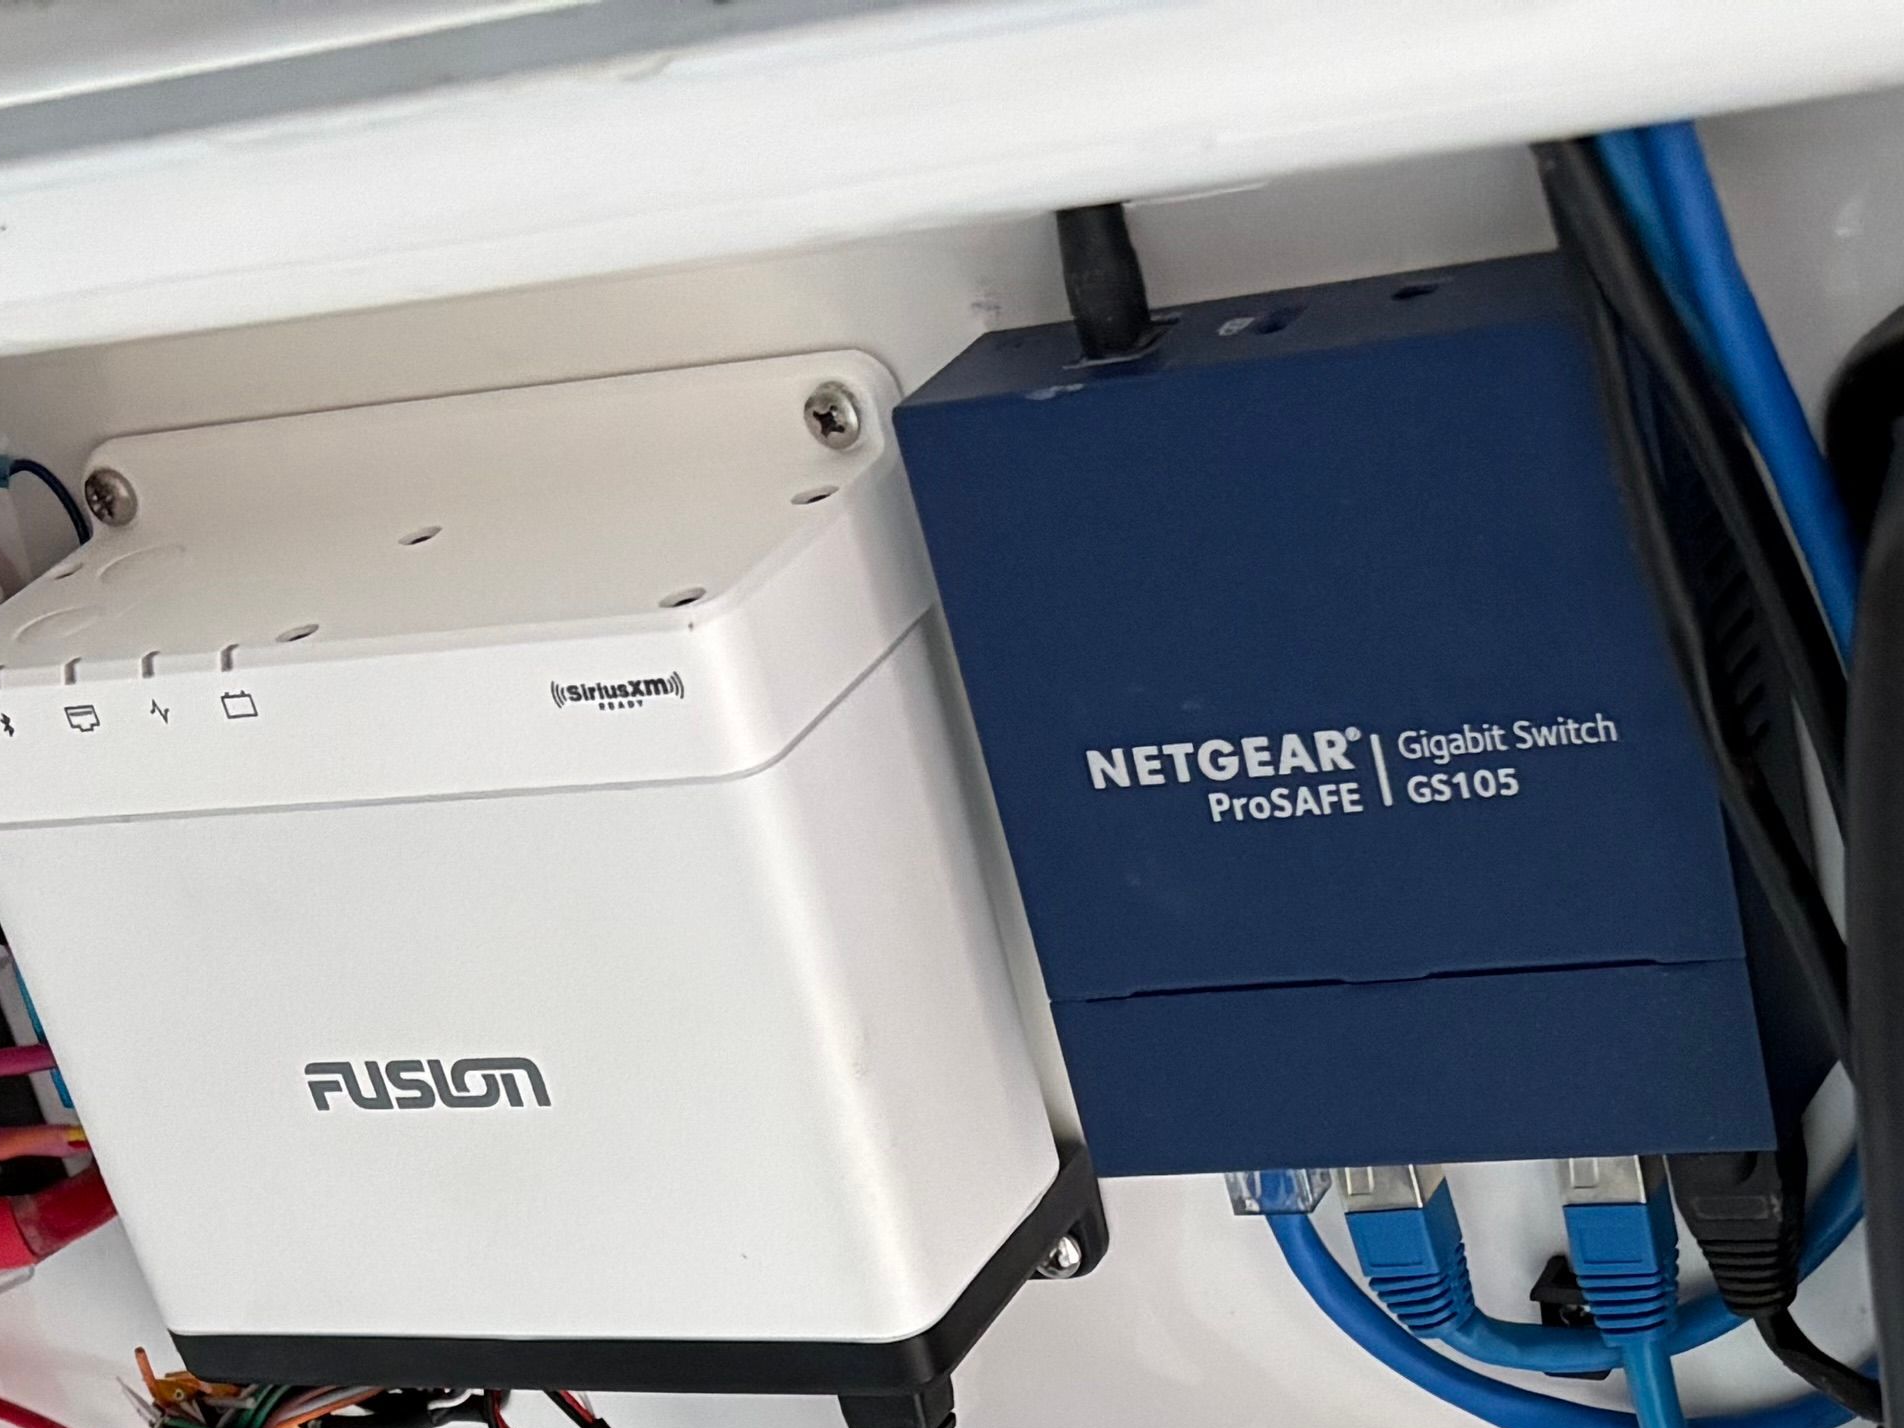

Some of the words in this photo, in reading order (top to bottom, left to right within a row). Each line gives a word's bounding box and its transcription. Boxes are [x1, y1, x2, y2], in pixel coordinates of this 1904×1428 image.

[598, 699, 643, 711] READY
[1397, 724, 1509, 765] Gigabit
[1514, 713, 1618, 750] Switch
[1207, 783, 1364, 823] ProSAFE
[1407, 768, 1520, 803] GS105
[304, 1057, 551, 1110] FUSION
